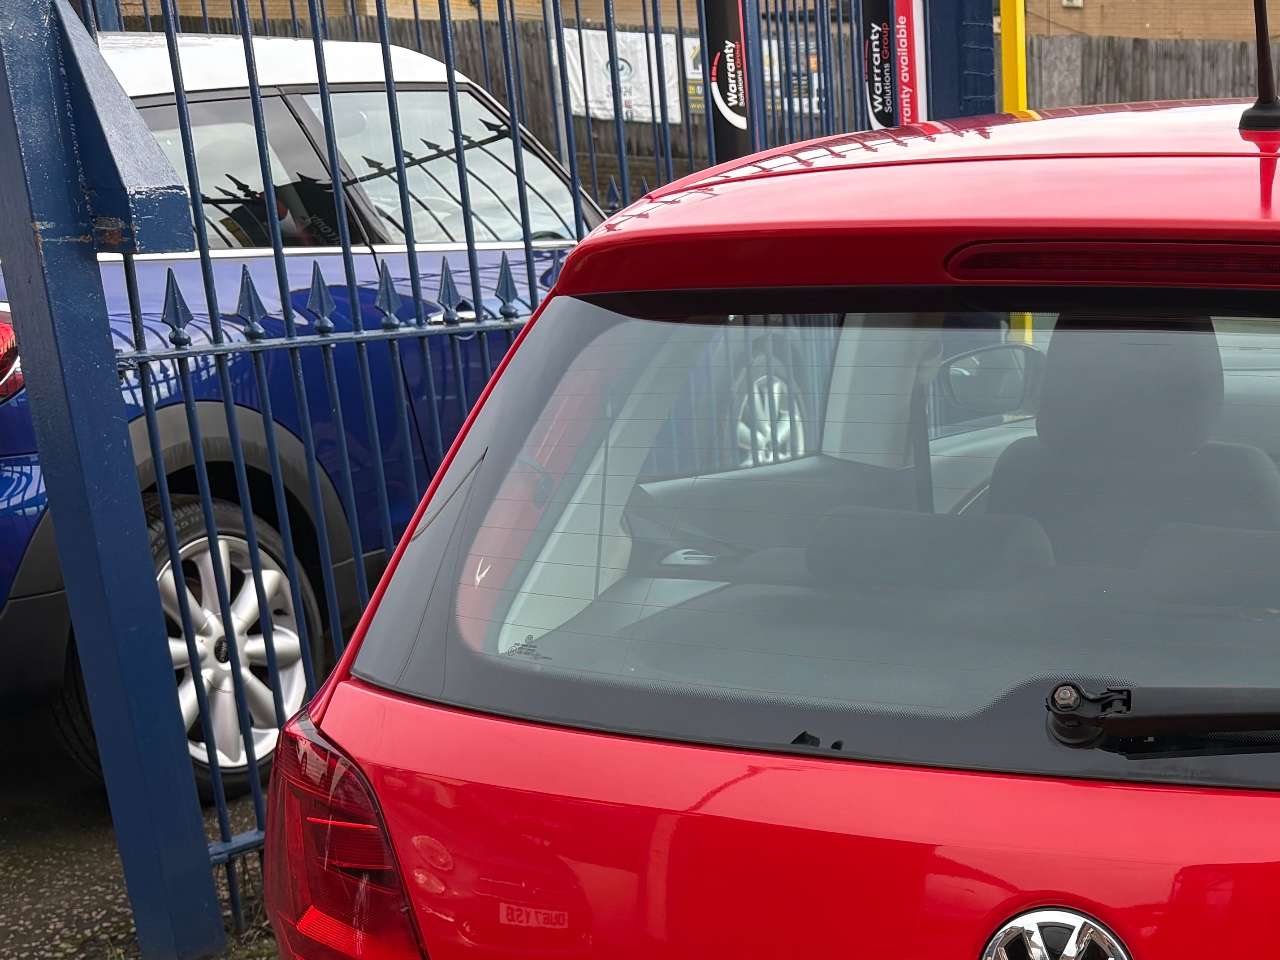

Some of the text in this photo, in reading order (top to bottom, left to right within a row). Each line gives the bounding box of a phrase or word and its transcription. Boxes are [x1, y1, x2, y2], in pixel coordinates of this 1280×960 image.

[725, 40, 737, 108] Warranty
[870, 22, 882, 113] Warranty
[881, 22, 892, 113] Solutions Group
[896, 15, 910, 83] available
